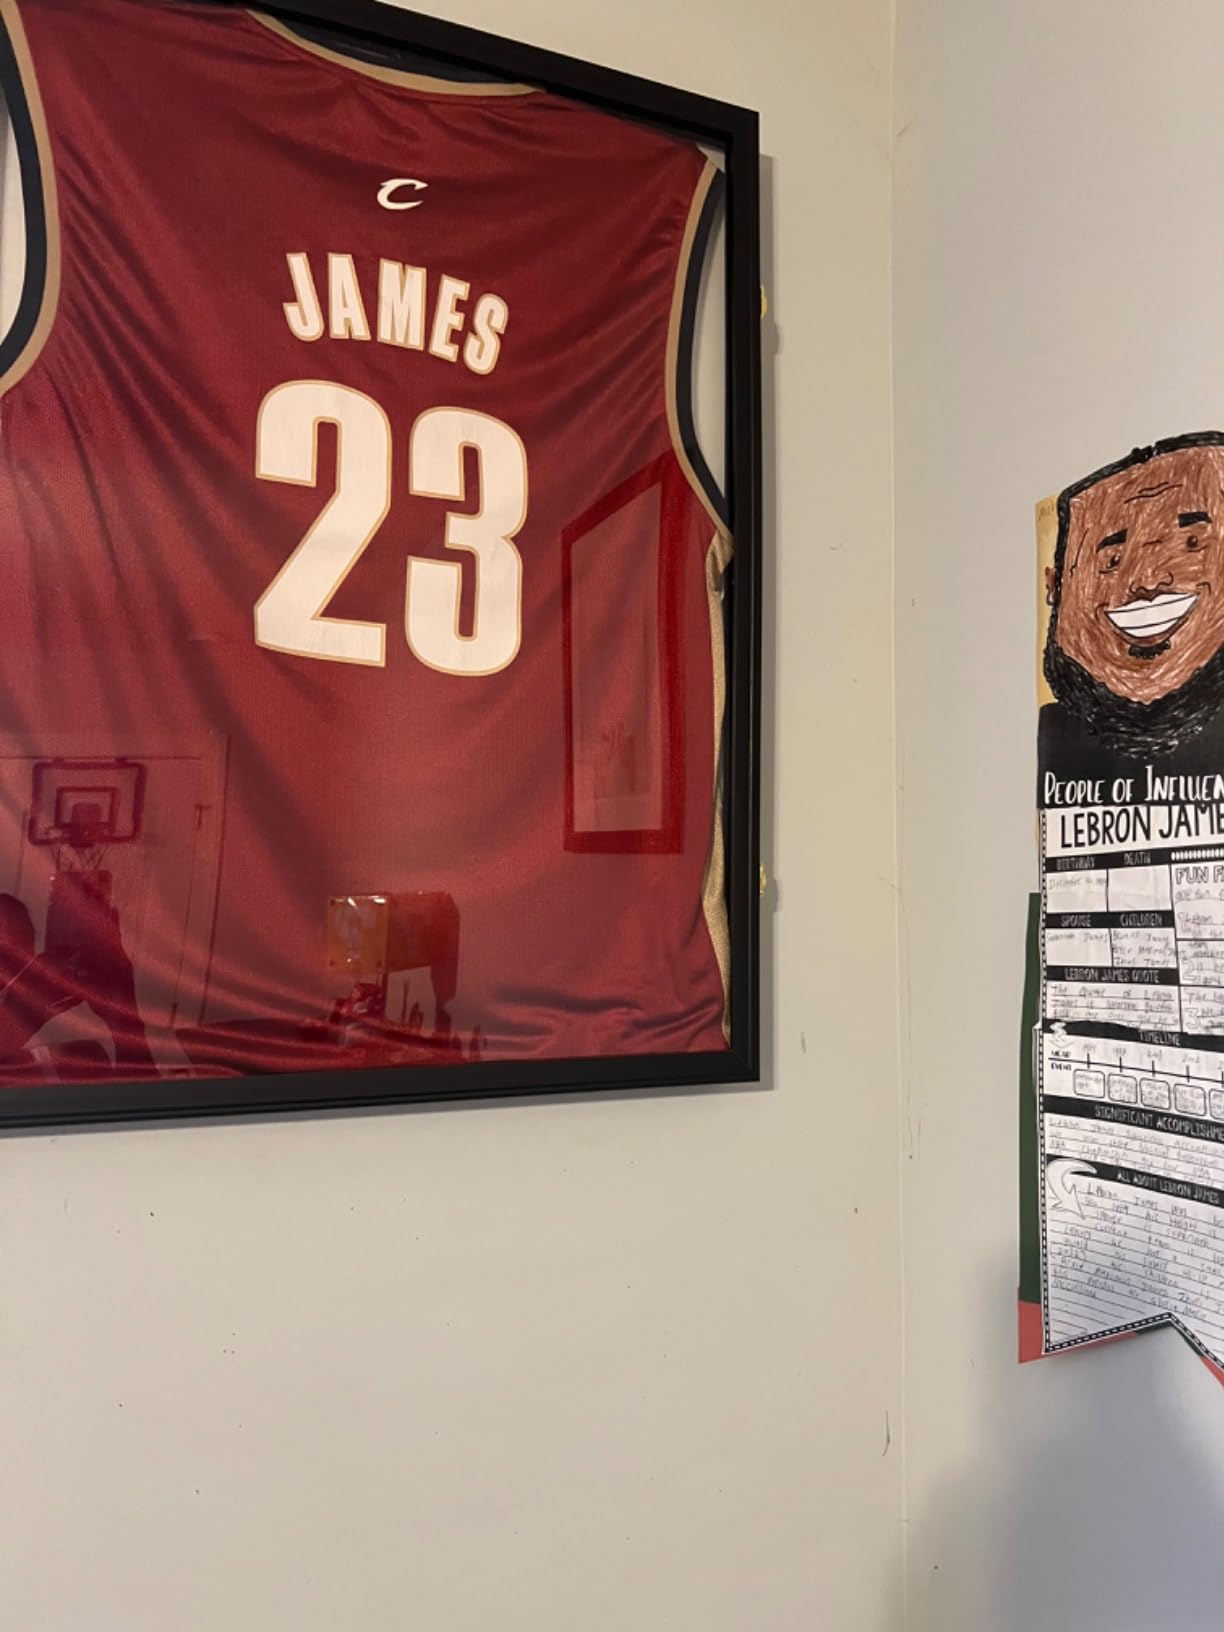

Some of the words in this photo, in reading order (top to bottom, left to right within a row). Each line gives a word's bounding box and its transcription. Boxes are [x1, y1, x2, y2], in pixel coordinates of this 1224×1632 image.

[283, 252, 509, 375] JAMES
[254, 379, 528, 677] 23
[1044, 771, 1106, 804] PEOPLE
[1112, 778, 1135, 803] OF
[1060, 806, 1151, 848] LEBRON
[1124, 852, 1151, 865] DEATH
[1175, 866, 1209, 885] FUN
[1060, 914, 1092, 927] SPOUSE
[1119, 912, 1163, 927] CHILDREN
[1064, 967, 1098, 981] LEBRON
[1101, 969, 1130, 982] JAMES
[1132, 970, 1160, 984] QUOTE
[1139, 1030, 1181, 1047] TIMELINE
[1051, 1063, 1072, 1072] EVENT
[1094, 1106, 1153, 1128] SIGNIFICANT
[1117, 1170, 1131, 1184] ALL
[1133, 1174, 1157, 1188] ABOUT
[1160, 1180, 1191, 1198] LEBRON
[1194, 1186, 1219, 1204] JAMES
